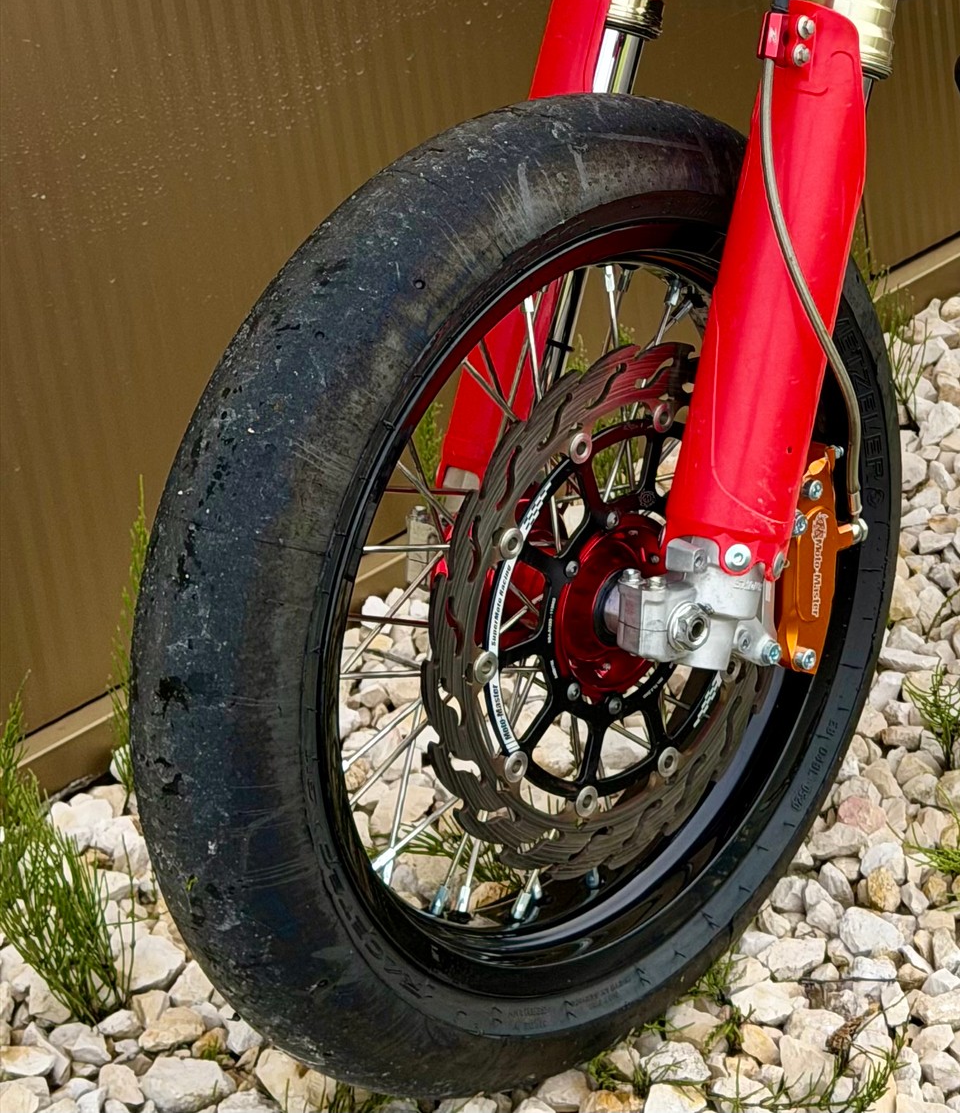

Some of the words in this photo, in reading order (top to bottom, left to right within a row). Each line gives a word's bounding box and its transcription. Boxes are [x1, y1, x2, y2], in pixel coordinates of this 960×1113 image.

[498, 564, 512, 597] Racing
[811, 538, 823, 618] Moto-Master
[492, 684, 513, 740] Moto-Master
